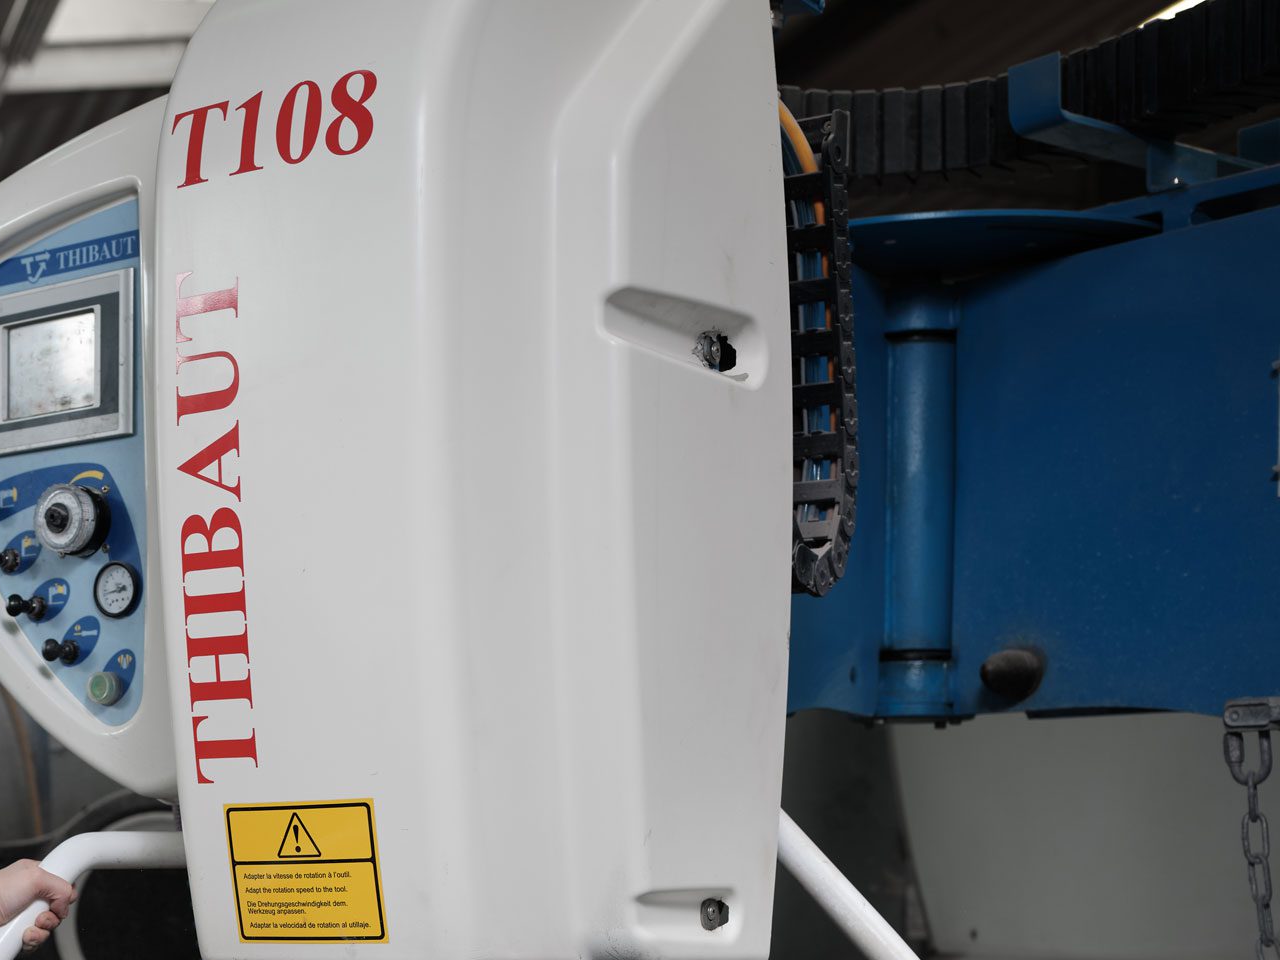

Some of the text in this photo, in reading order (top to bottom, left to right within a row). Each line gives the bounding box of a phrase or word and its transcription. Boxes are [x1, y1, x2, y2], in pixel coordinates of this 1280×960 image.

[171, 69, 377, 189] T108
[56, 236, 136, 270] THIBAUT
[175, 272, 258, 784] THIBAUT
[243, 873, 265, 881] Adapter
[327, 871, 333, 879] à
[257, 900, 331, 908] Drehungsgeschwindigkeit
[249, 922, 271, 930] Adaptar
[348, 921, 372, 929] utillaje.
